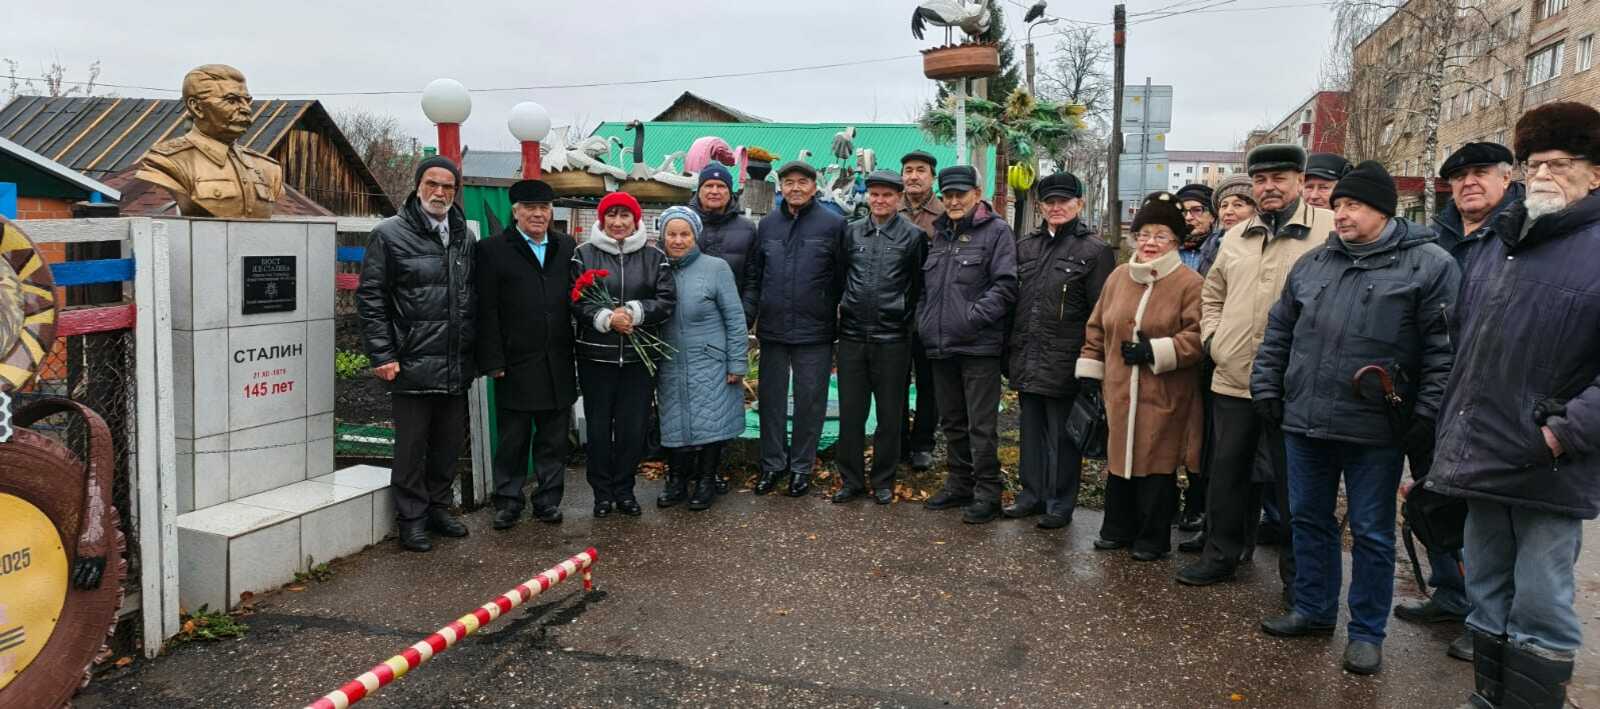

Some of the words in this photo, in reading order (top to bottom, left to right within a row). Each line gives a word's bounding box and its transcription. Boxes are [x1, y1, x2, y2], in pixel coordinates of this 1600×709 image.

[233, 343, 303, 364] СТАЛИН
[243, 381, 268, 399] 145
[272, 380, 295, 395] лет
[0, 547, 31, 575] 025
